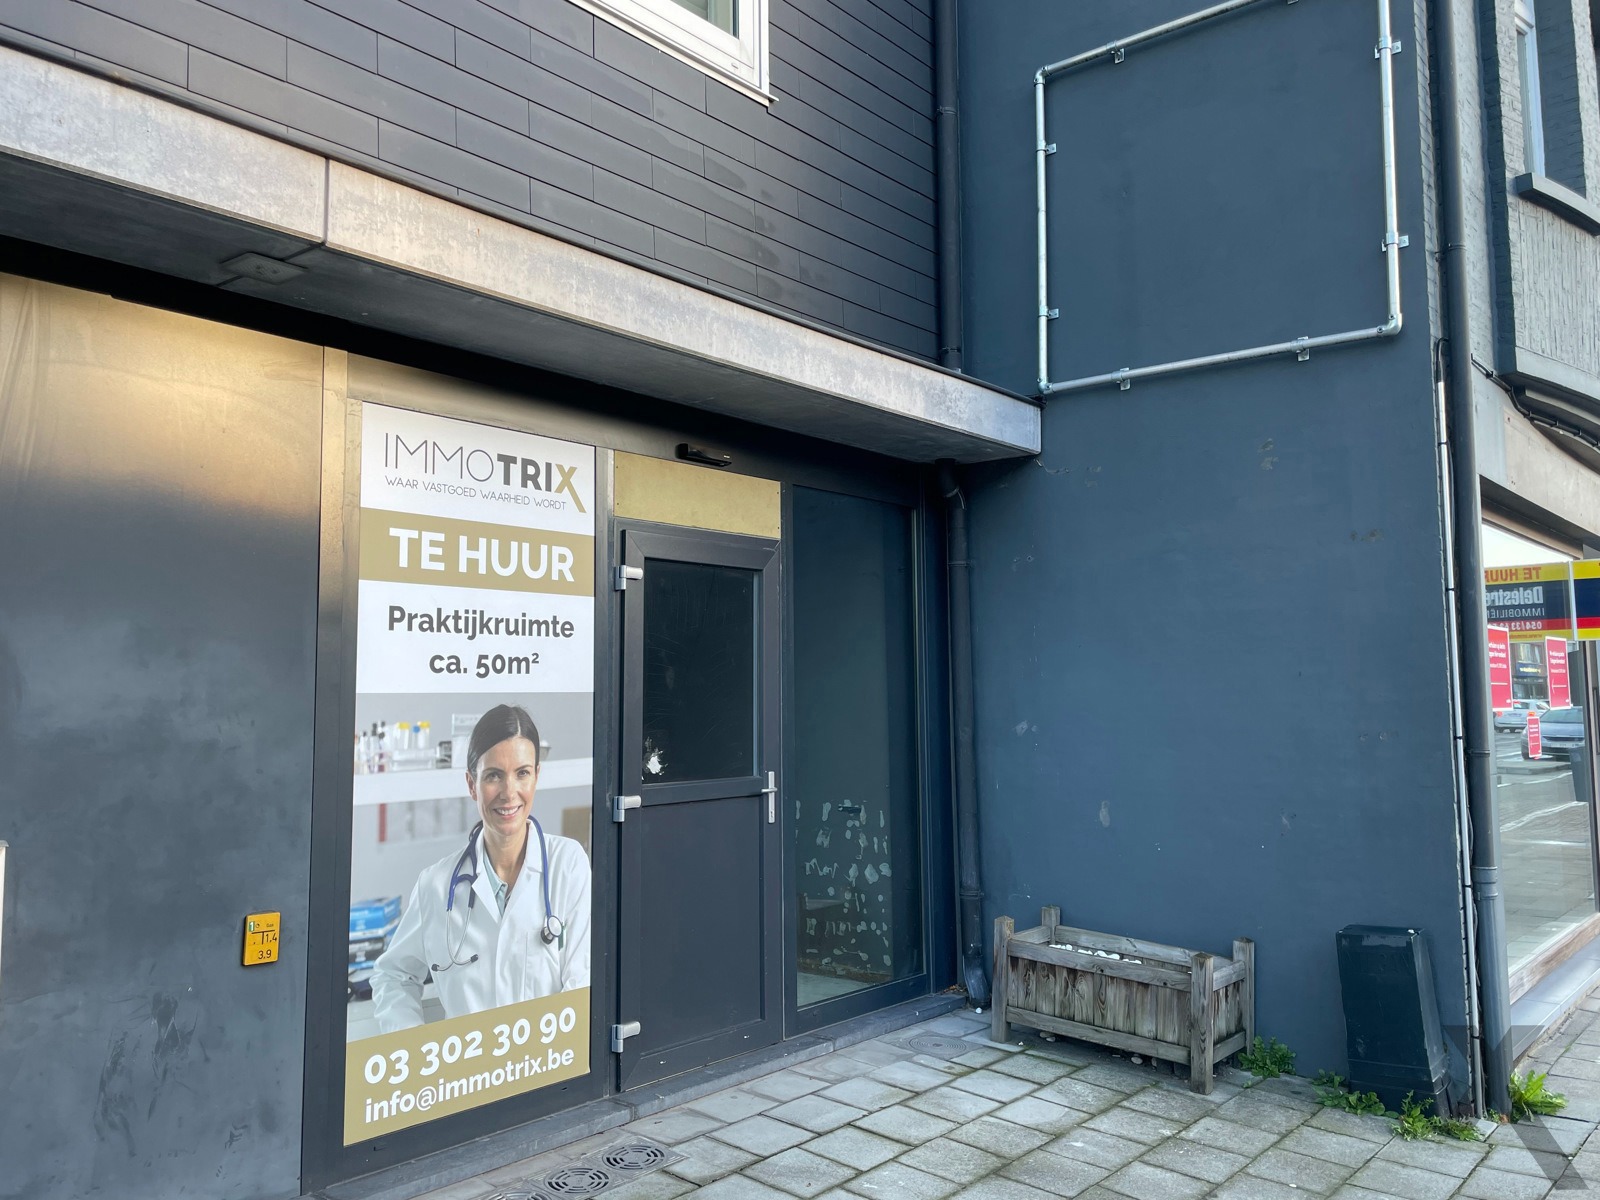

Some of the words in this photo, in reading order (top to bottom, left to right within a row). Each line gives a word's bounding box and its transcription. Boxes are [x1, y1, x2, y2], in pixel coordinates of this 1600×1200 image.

[385, 432, 587, 514] IMMOTRIX
[385, 475, 418, 490] WAAR
[422, 480, 477, 498] VASTGOED
[480, 489, 530, 506] WAARHEID
[533, 497, 567, 511] WORDT
[389, 527, 446, 572] TE
[458, 535, 575, 582] HUUR
[388, 605, 575, 641] Praktijkruimte
[429, 654, 468, 675] ca.
[475, 652, 540, 679] 50m²
[364, 1049, 410, 1085] 03
[420, 1030, 483, 1077] 302
[492, 1018, 531, 1057] 30
[539, 1006, 577, 1044] 90
[365, 1048, 575, 1124] info@immotrix.be
